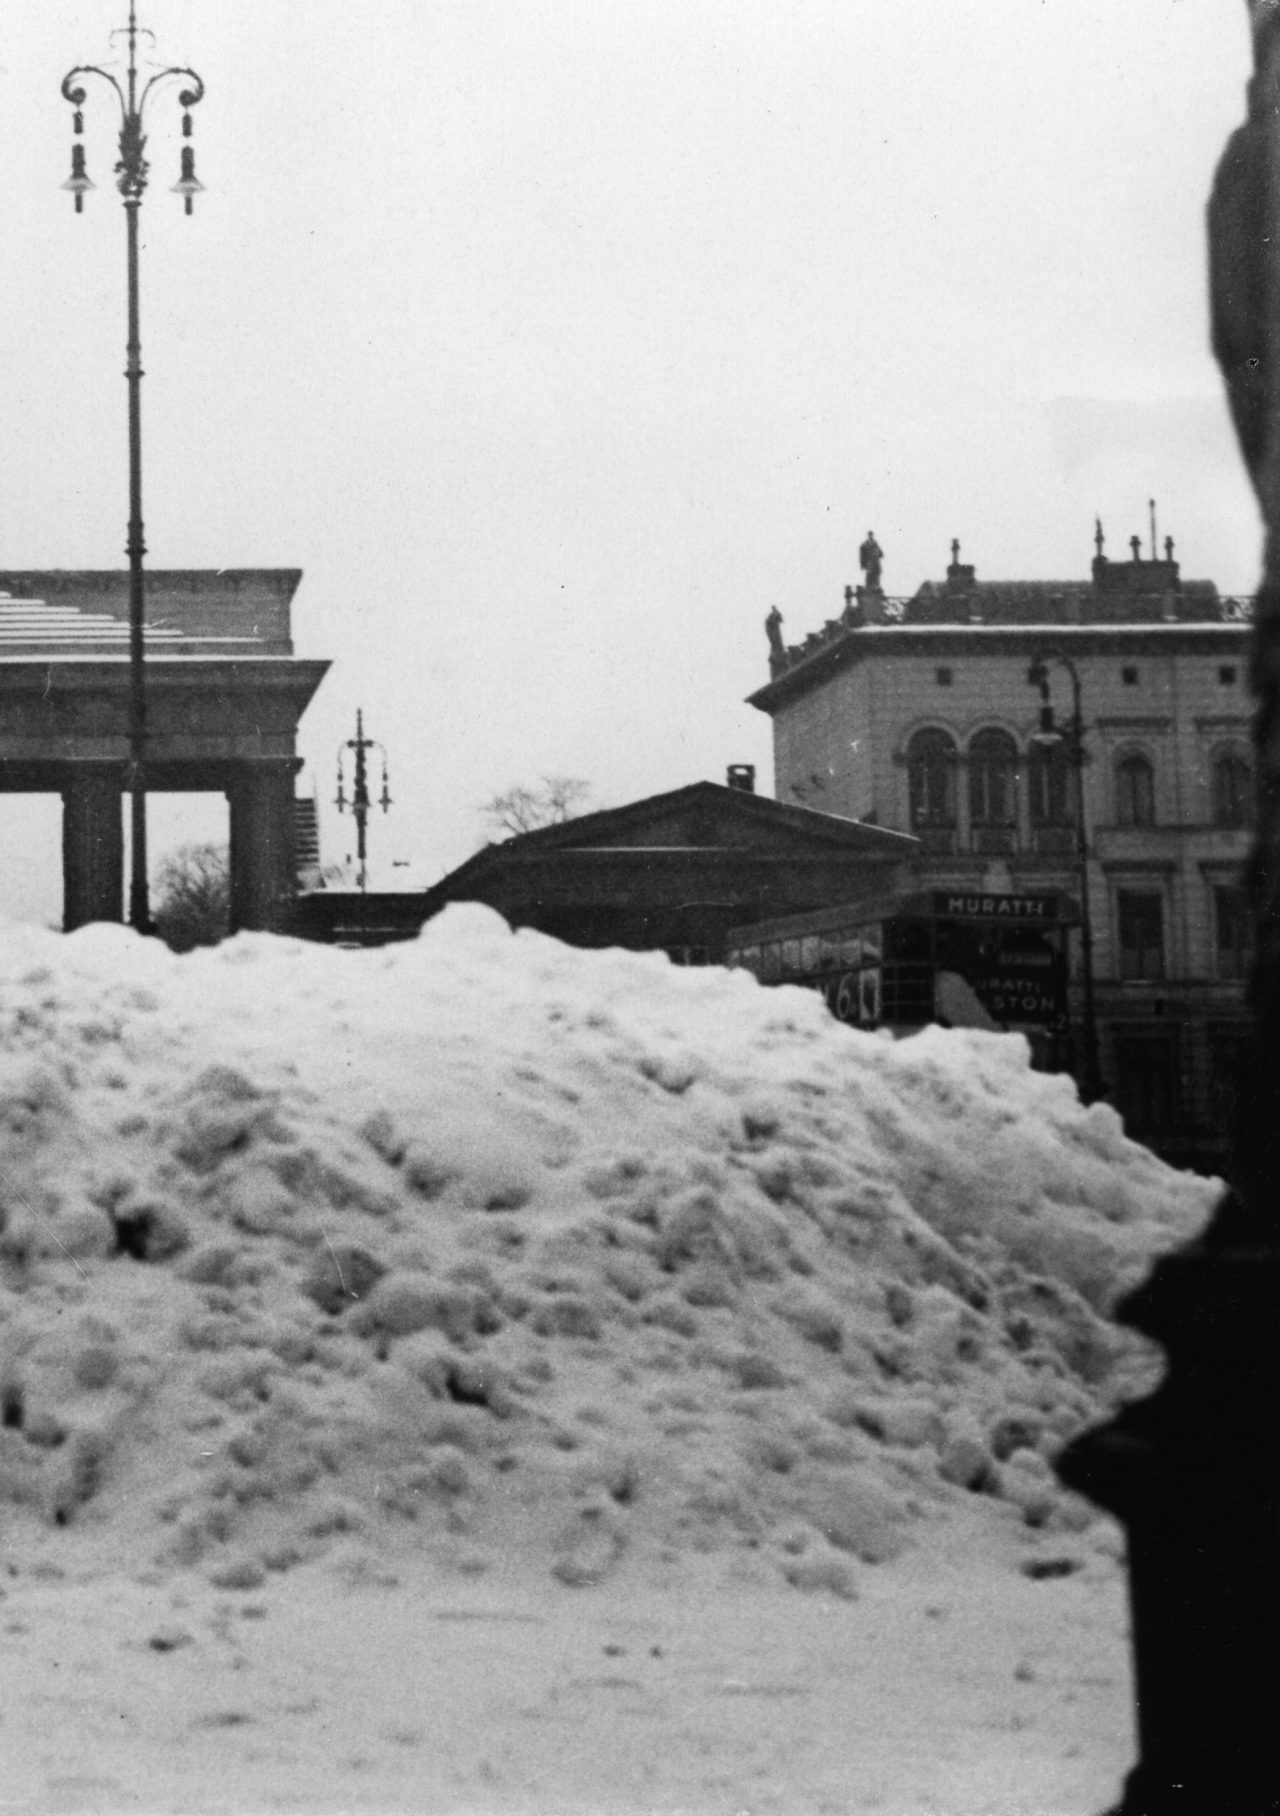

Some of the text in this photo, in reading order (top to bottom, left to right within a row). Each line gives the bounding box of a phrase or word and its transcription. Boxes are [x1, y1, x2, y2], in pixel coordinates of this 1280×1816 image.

[948, 898, 1043, 915] MURATTI
[977, 977, 1040, 994] URATTI
[988, 994, 1055, 1011] STON
